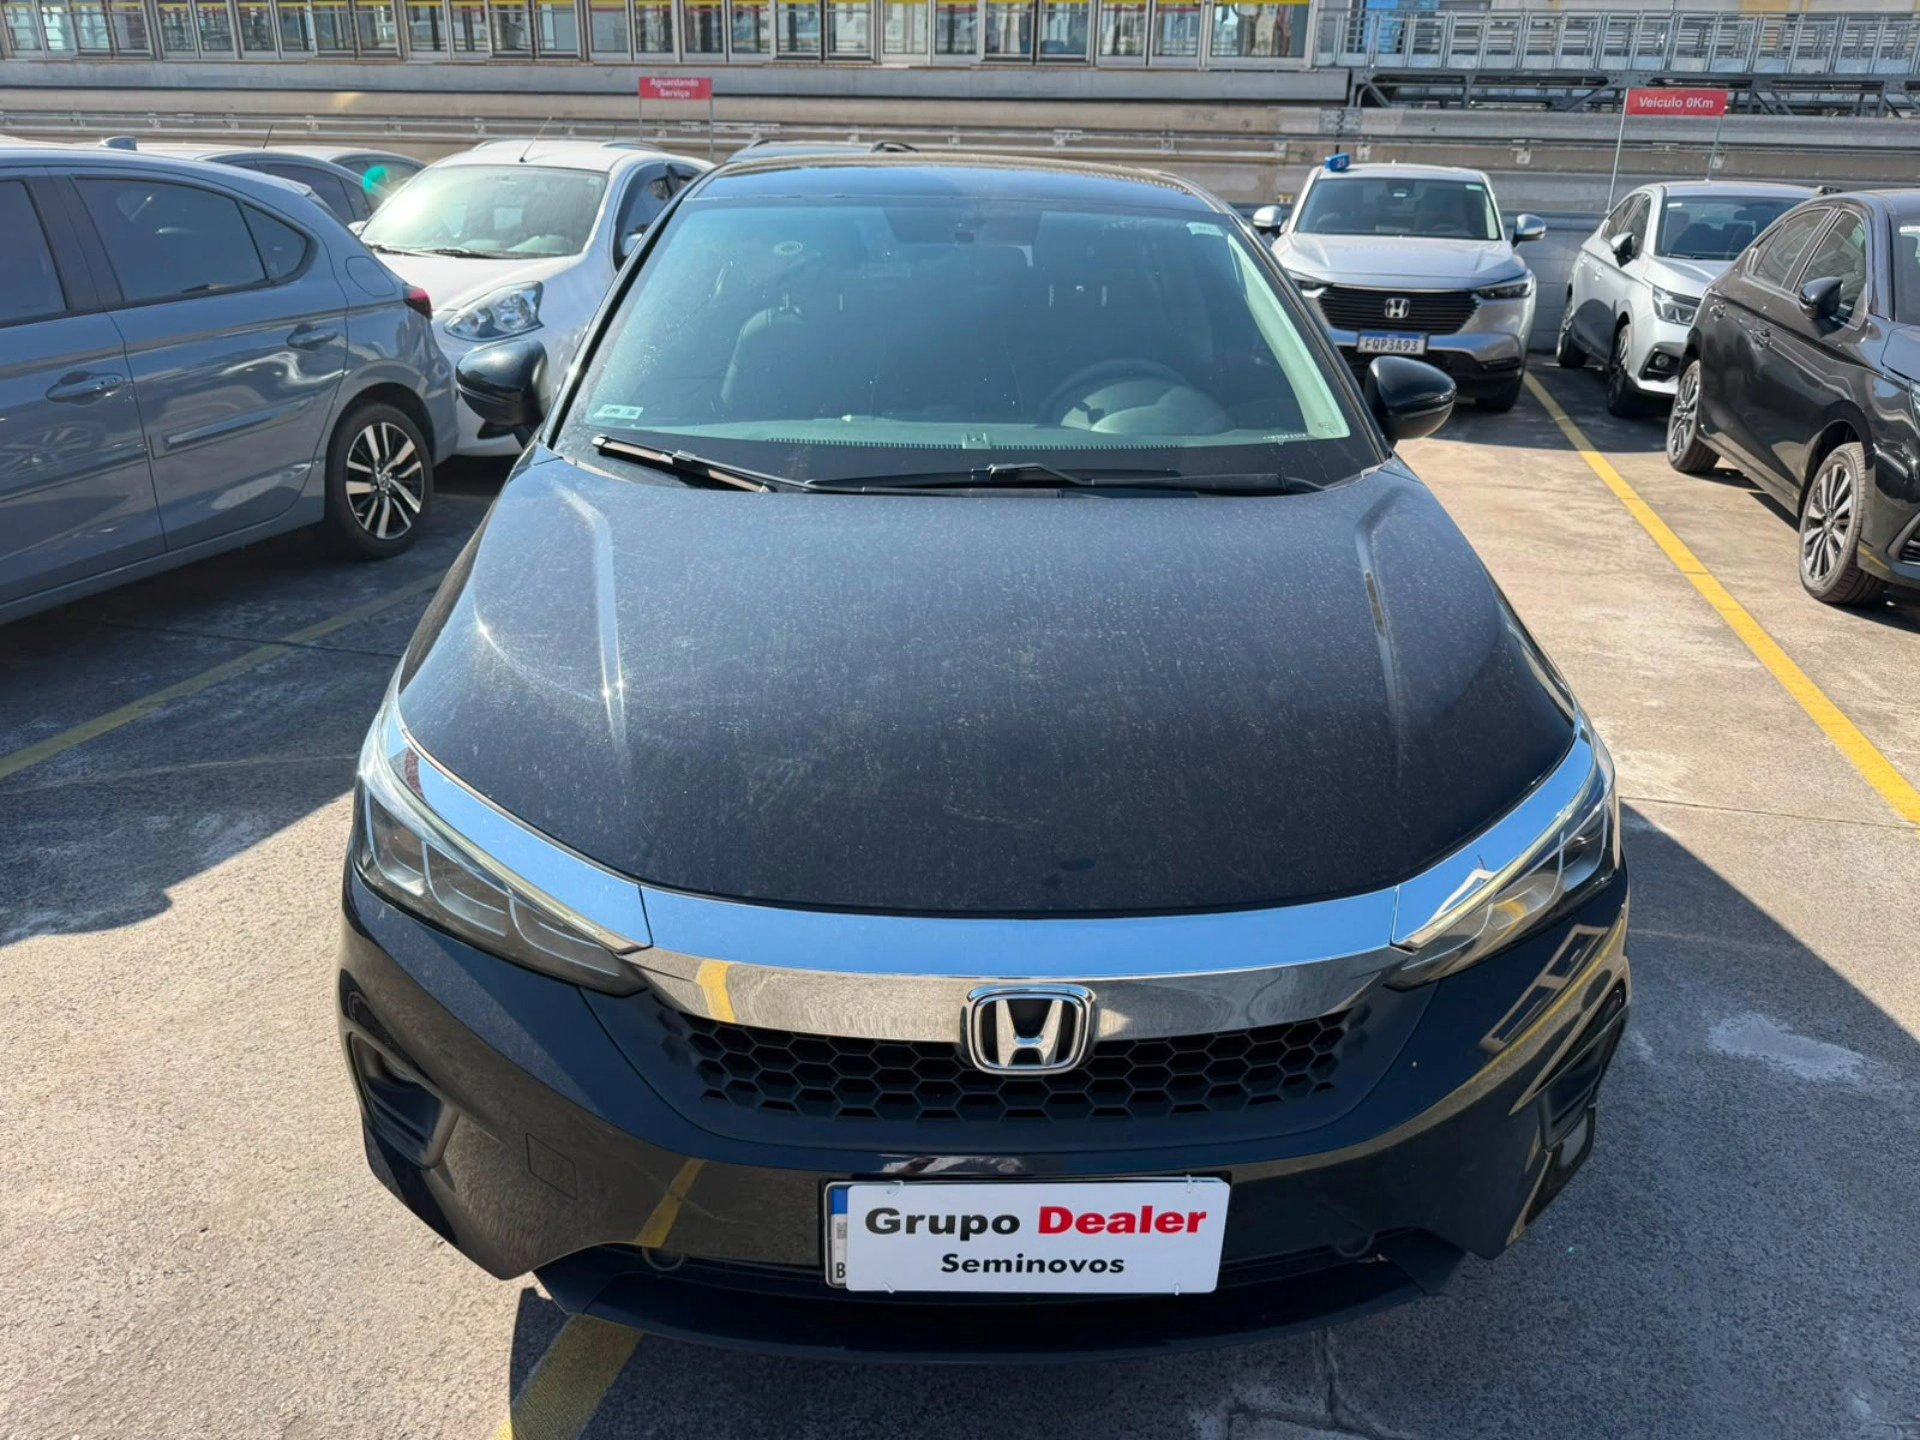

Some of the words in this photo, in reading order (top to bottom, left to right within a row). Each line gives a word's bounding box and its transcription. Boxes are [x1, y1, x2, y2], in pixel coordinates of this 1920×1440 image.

[649, 78, 699, 87] Aguardando
[659, 88, 691, 99] Serviço
[1639, 96, 1683, 108] Veículo
[1686, 97, 1714, 108] 0Km
[865, 1207, 1021, 1241] Grupo
[1038, 1205, 1207, 1234] Dealer
[941, 1253, 1125, 1273] Seminovos
[836, 1262, 846, 1279] B
